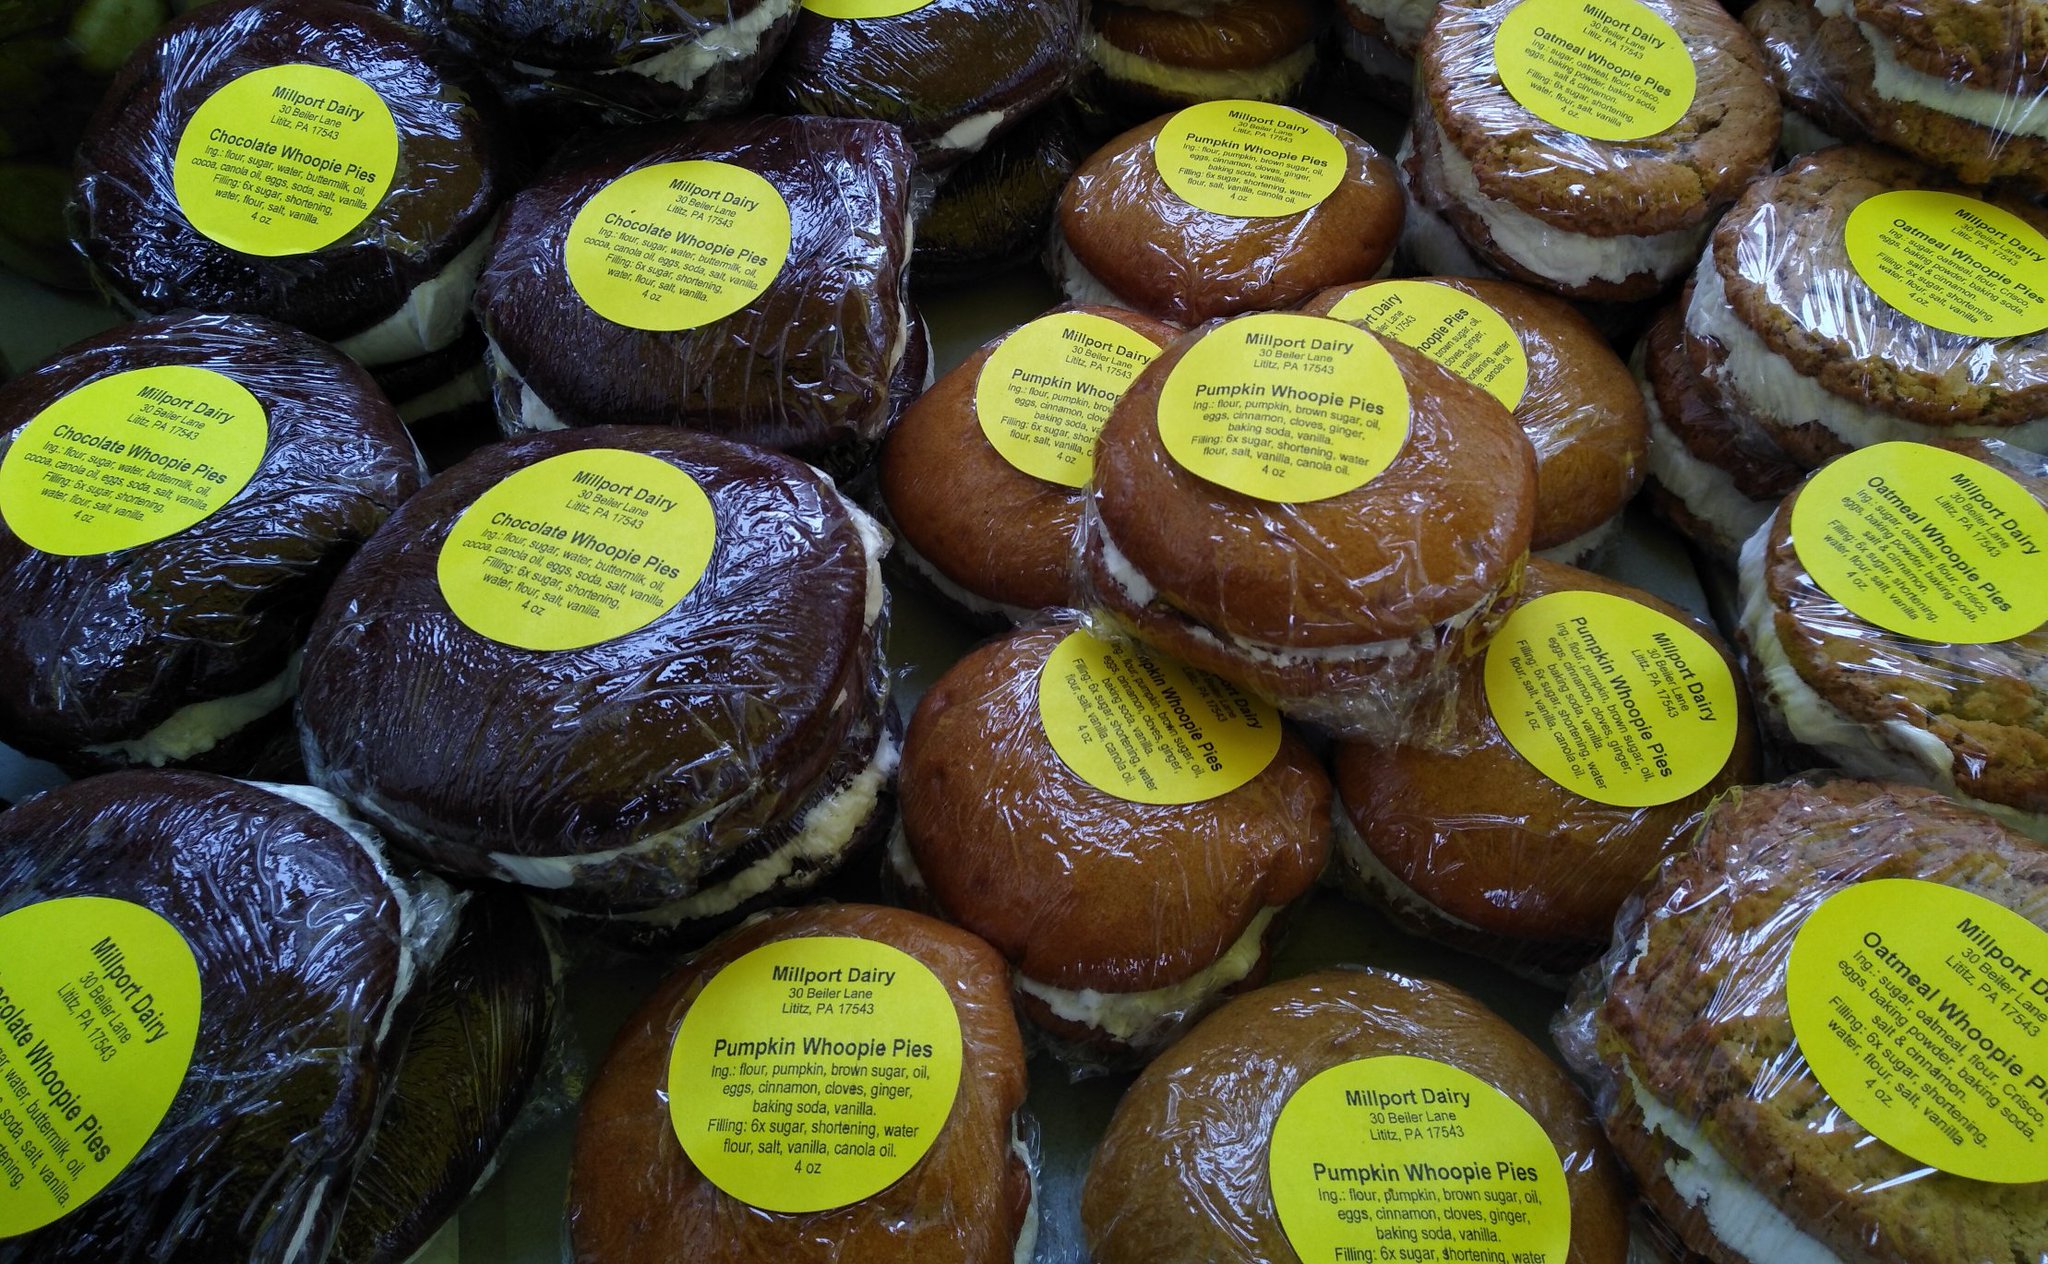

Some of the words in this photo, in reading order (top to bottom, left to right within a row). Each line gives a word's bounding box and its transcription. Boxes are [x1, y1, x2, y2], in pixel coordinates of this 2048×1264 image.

[1583, 3, 1631, 32] Millport
[1631, 26, 1666, 49] Dairy
[1534, 27, 1586, 56] Oatmeal
[1587, 50, 1642, 82] Whoopie
[1644, 77, 1671, 96] Pies
[271, 86, 325, 109] Millport
[326, 99, 365, 122] Dairy
[1526, 68, 1553, 85] Filling:
[1554, 81, 1564, 91] 6x
[1565, 88, 1589, 103] sugar,
[1591, 99, 1634, 124] shortening,
[1228, 110, 1275, 126] Millport
[1277, 120, 1309, 134] Dairy
[210, 128, 277, 155] Chocolate
[280, 145, 342, 173] Whoopie
[344, 163, 376, 183] Pies
[1186, 133, 1240, 150] Pumpkin
[1244, 142, 1298, 161] Whoopie
[1301, 155, 1328, 167] Pies
[668, 178, 721, 200] Millport
[722, 192, 760, 212] Dairy
[1208, 163, 1234, 175] baking
[1235, 169, 1257, 178] soda,
[1260, 174, 1286, 184] vanilla.
[215, 189, 240, 203] water,
[242, 194, 265, 210] flour,
[267, 204, 285, 216] salt,
[289, 210, 319, 225] vanilla.
[666, 204, 688, 217] Lititz,
[690, 210, 704, 221] PA
[707, 215, 734, 228] 17543
[604, 213, 672, 239] Chocolate
[675, 231, 735, 257] Whoopie
[737, 248, 768, 266] Pies
[1954, 209, 2008, 240] Millport
[2007, 237, 2046, 262] Dairy
[1893, 219, 1951, 251] Oatmeal
[1951, 247, 2012, 285] Whoopie
[2012, 283, 2046, 304] Pies
[1371, 293, 1403, 316] Dairy
[1878, 264, 1904, 282] water,
[1905, 279, 1927, 295] flour,
[1928, 293, 1947, 307] salt,
[1949, 304, 1978, 323] vanilla
[1062, 328, 1114, 352] Millport
[1115, 345, 1151, 365] Dairy
[1245, 333, 1306, 349] Millport
[1311, 339, 1354, 355] Dairy
[1417, 328, 1449, 352] oopie
[1443, 309, 1469, 328] Pies
[1259, 348, 1273, 357] 30
[1275, 350, 1305, 360] Beiler
[1307, 353, 1333, 362] Lane
[1011, 368, 1072, 390] Pumpkin
[1195, 383, 1265, 398] Pumpkin
[1272, 384, 1344, 406] Whoopie
[1349, 396, 1384, 415] Pies
[126, 413, 150, 428] Lititz,
[151, 420, 168, 431] PA
[169, 425, 200, 440] 17543
[136, 386, 195, 410] Millport
[192, 402, 236, 424] Dairy
[53, 424, 126, 454] Chocolate
[126, 443, 191, 472] Whoopie
[191, 463, 227, 484] Pies
[572, 470, 634, 497] Millport
[633, 488, 678, 513] Dairy
[1950, 473, 2006, 520] Millport
[2000, 518, 2041, 555] Dairy
[491, 512, 568, 540] Chocolate
[570, 530, 641, 564] Whoopie
[643, 555, 680, 579] Pies
[504, 532, 527, 547] flour,
[528, 540, 560, 557] sugar,
[563, 550, 593, 568] water,
[594, 559, 646, 586] buttermilk,
[649, 581, 665, 593] oil,
[1868, 476, 1927, 524] Oatmeal
[1920, 522, 1980, 582] Whoopie
[1977, 582, 2012, 612] Pies
[1824, 535, 1850, 557] water,
[1849, 555, 1872, 576] flour,
[1870, 575, 1891, 594] salt,
[1889, 593, 1919, 620] vanilla
[1570, 616, 1615, 675] Pumpkin
[1609, 674, 1653, 740] Whoopie
[1646, 742, 1672, 777] Pies
[1631, 649, 1650, 672] Lititz,
[1646, 672, 1662, 687] PA
[1657, 689, 1679, 718] 17543
[1652, 632, 1696, 680] Millport
[1686, 681, 1717, 721] Dairy
[1081, 732, 1093, 744] oz
[1161, 687, 1203, 742] Whoopie
[1197, 741, 1223, 772] Pies
[1509, 656, 1527, 679] flour,
[1522, 680, 1540, 699] salt,
[1534, 699, 1556, 731] vanilla,
[1553, 731, 1576, 763] canola
[1571, 764, 1585, 779] oil.
[1956, 917, 2032, 982] Millport
[90, 936, 144, 1002] Millport
[130, 993, 169, 1044] Dairy
[772, 965, 843, 986] Millport
[847, 967, 896, 987] Dairy
[788, 987, 804, 999] 30
[807, 987, 841, 999] Beiler
[844, 988, 873, 999] Lane
[57, 982, 80, 1016] Lititz,
[75, 1008, 95, 1031] PA
[87, 1027, 117, 1063] 17543
[782, 1002, 812, 1016] Lititz,
[816, 1003, 834, 1014] PA
[839, 1003, 874, 1015] 17543
[1863, 932, 1941, 1002] Oatmeal
[1937, 997, 2024, 1077] Whoopie
[713, 1037, 796, 1060] Pumpkin
[803, 1037, 886, 1061] Whoopie
[892, 1038, 933, 1058] Pies
[1871, 1015, 1896, 1038] salt
[1894, 1035, 1907, 1048] &
[1905, 1046, 1966, 1104] cinnamon.
[722, 1083, 754, 1097] eggs,
[758, 1080, 821, 1096] cinnamon,
[825, 1081, 867, 1098] cloves,
[870, 1082, 912, 1100] ginger,
[739, 1062, 768, 1077] flour,
[771, 1062, 827, 1078] pumpkin,
[831, 1062, 868, 1077] brown
[871, 1066, 909, 1081] sugar,
[913, 1065, 930, 1080] oil,
[1828, 995, 1867, 1034] Filling:
[1866, 1032, 1883, 1050] 6x
[1882, 1048, 1920, 1085] sugar,
[1920, 1083, 1988, 1148] shortening,
[24, 1038, 82, 1121] Whoopie
[74, 1114, 111, 1163] Pies
[1345, 1089, 1418, 1110] Millport
[1421, 1088, 1470, 1108] Dairy
[1370, 1129, 1402, 1142] Lititz,
[1404, 1128, 1424, 1140] PA
[1426, 1124, 1465, 1139] 17543
[1313, 1162, 1400, 1186] Pumpkin
[1403, 1161, 1492, 1185] Whoopie
[1495, 1161, 1538, 1182] Pies
[1375, 1225, 1418, 1243] baking
[1421, 1226, 1456, 1242] soda,
[1458, 1227, 1501, 1243] vanilla.
